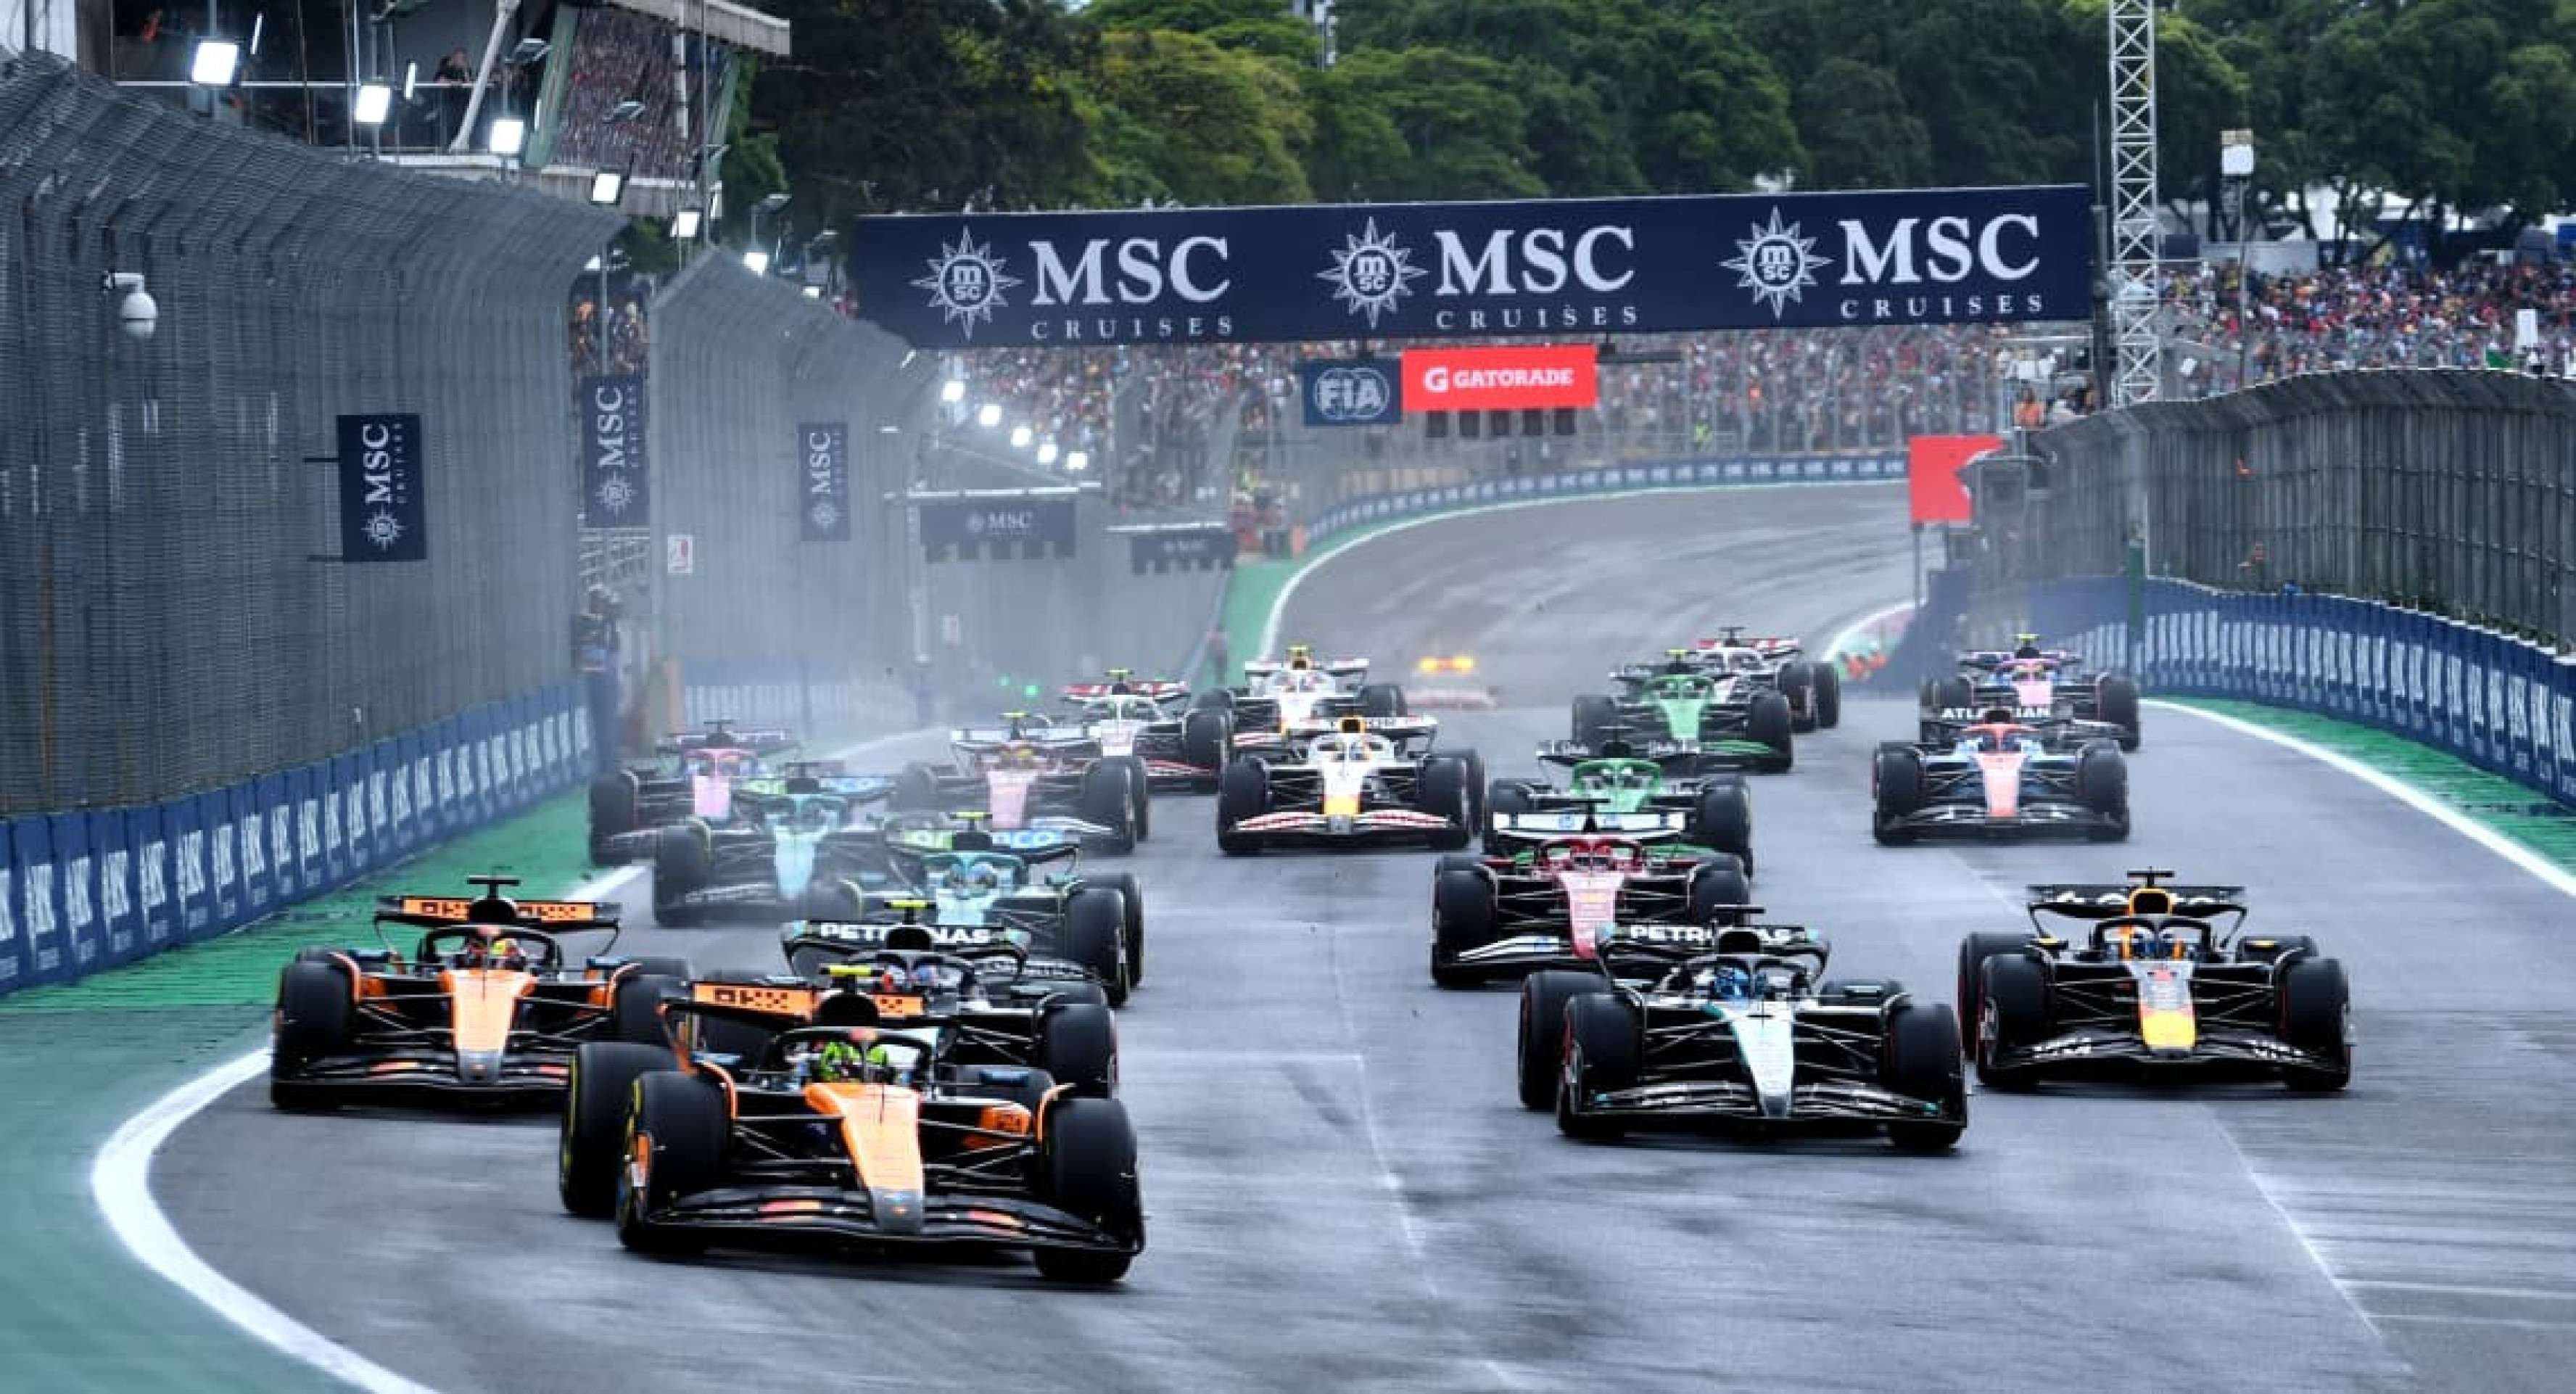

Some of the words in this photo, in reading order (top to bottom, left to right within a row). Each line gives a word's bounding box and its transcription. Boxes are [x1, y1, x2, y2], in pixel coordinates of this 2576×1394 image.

[1028, 236, 1230, 305] MSC
[1434, 225, 1634, 296] MSC
[1838, 214, 2039, 285] MSC
[1031, 317, 1233, 339] CRUISES
[1436, 305, 1636, 330] CRUISES
[1840, 294, 2042, 318] CRUISES
[1320, 379, 1382, 411] FIA
[1424, 367, 1449, 392] G
[1453, 368, 1573, 389] GATORADE
[597, 387, 626, 469] MSC
[362, 424, 391, 504] MSC
[809, 432, 832, 495] MSC
